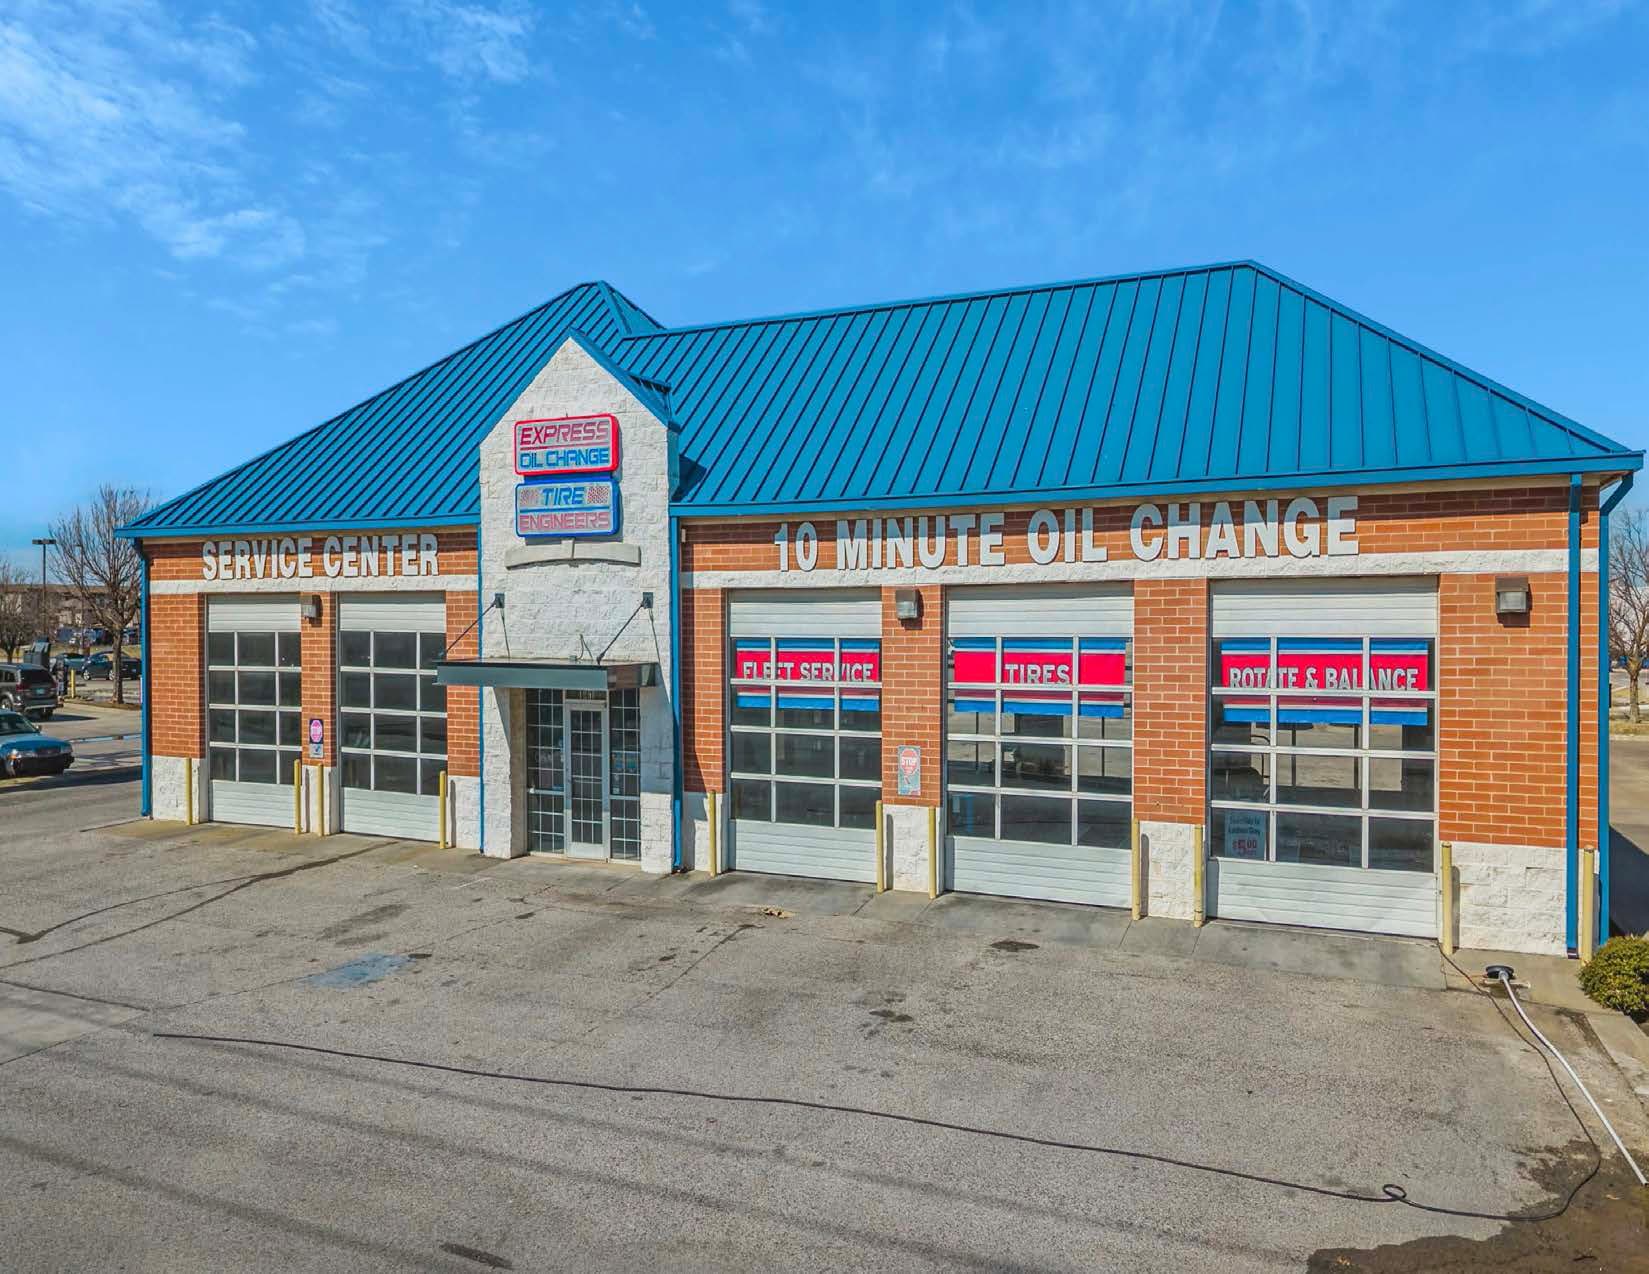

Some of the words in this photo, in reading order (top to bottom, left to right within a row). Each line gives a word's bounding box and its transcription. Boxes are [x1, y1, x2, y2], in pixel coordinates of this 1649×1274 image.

[520, 421, 610, 446] EXPRESS
[520, 451, 543, 468] OIL
[546, 448, 610, 467] CHANGE
[540, 486, 585, 506] TIRE
[519, 511, 610, 531] ENGINEERS
[774, 521, 818, 573] 10
[836, 512, 1006, 571] MINUTE
[1027, 507, 1108, 565] OIL
[1129, 495, 1359, 562] CHANGE
[202, 536, 314, 580] SERVICE
[323, 533, 439, 578] CENTER
[1005, 663, 1070, 686] TIRES
[1305, 667, 1318, 689] &
